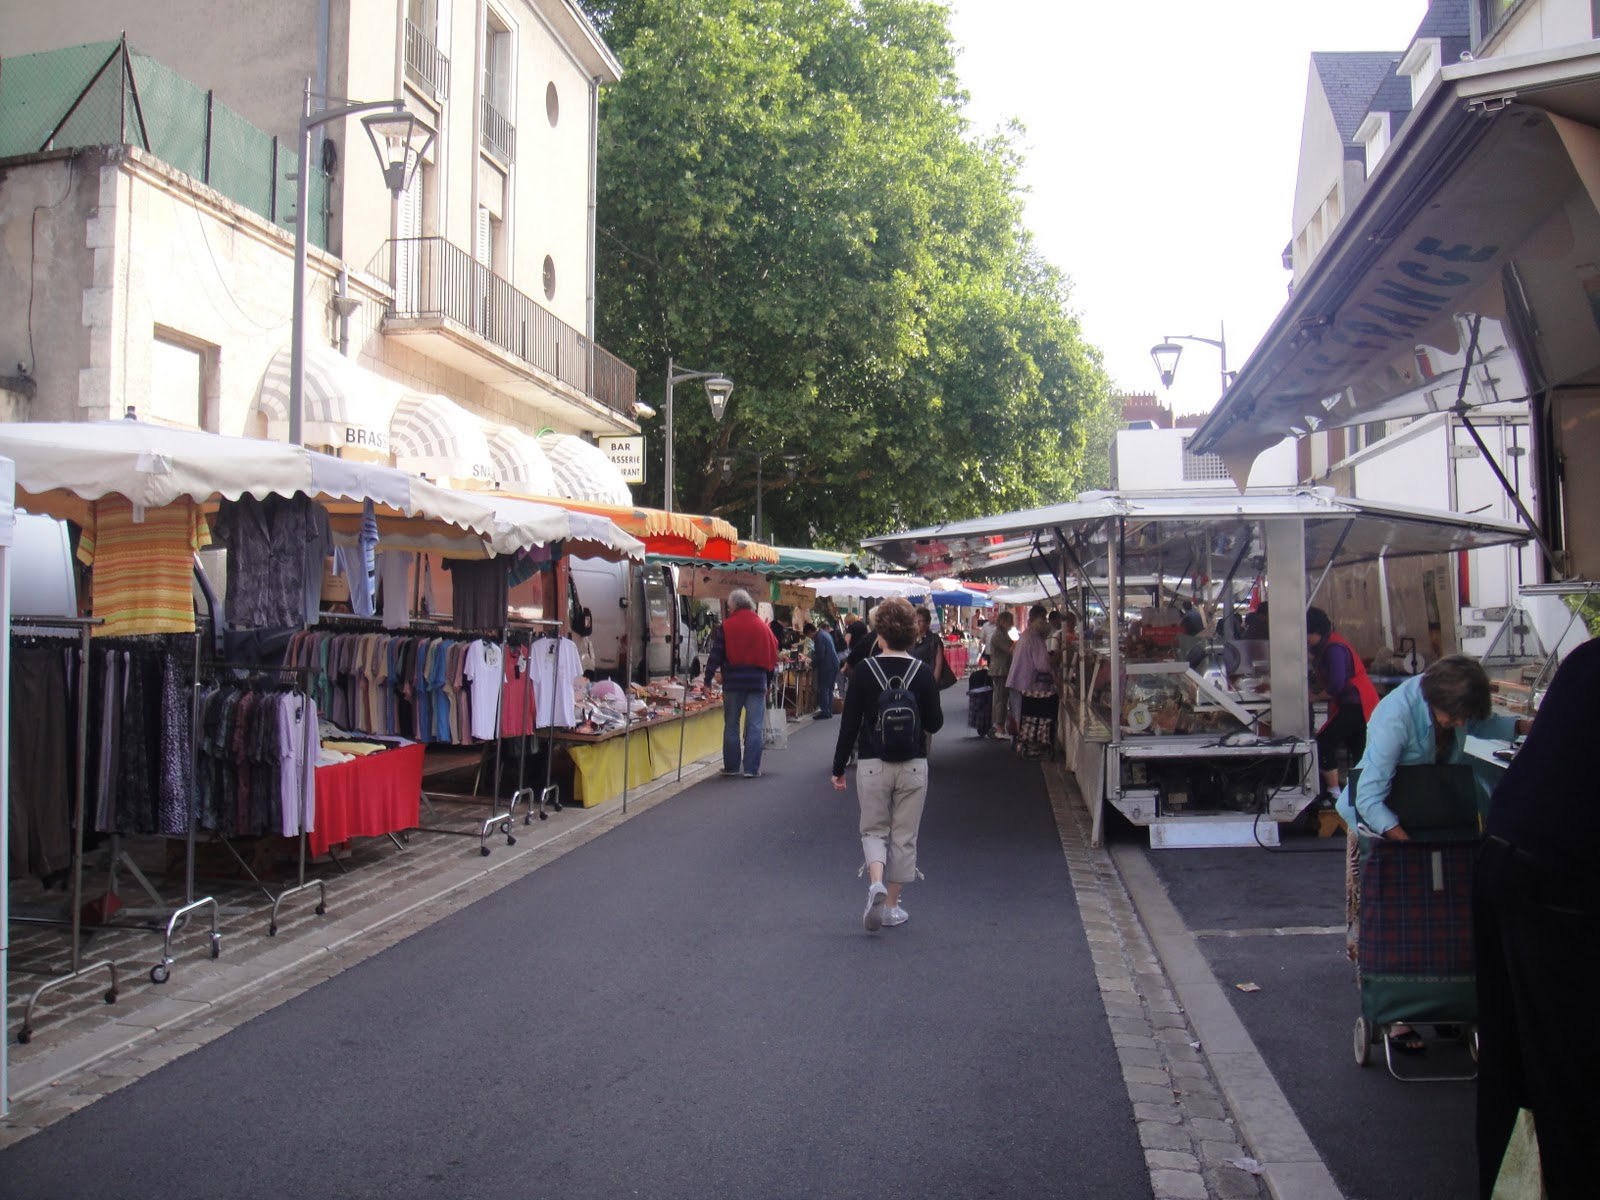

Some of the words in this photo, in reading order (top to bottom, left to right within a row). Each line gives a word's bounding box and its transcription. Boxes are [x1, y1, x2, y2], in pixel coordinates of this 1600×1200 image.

[1331, 236, 1499, 350] FRANCE
[611, 443, 631, 451] BAR
[607, 455, 640, 464] ASSERIE
